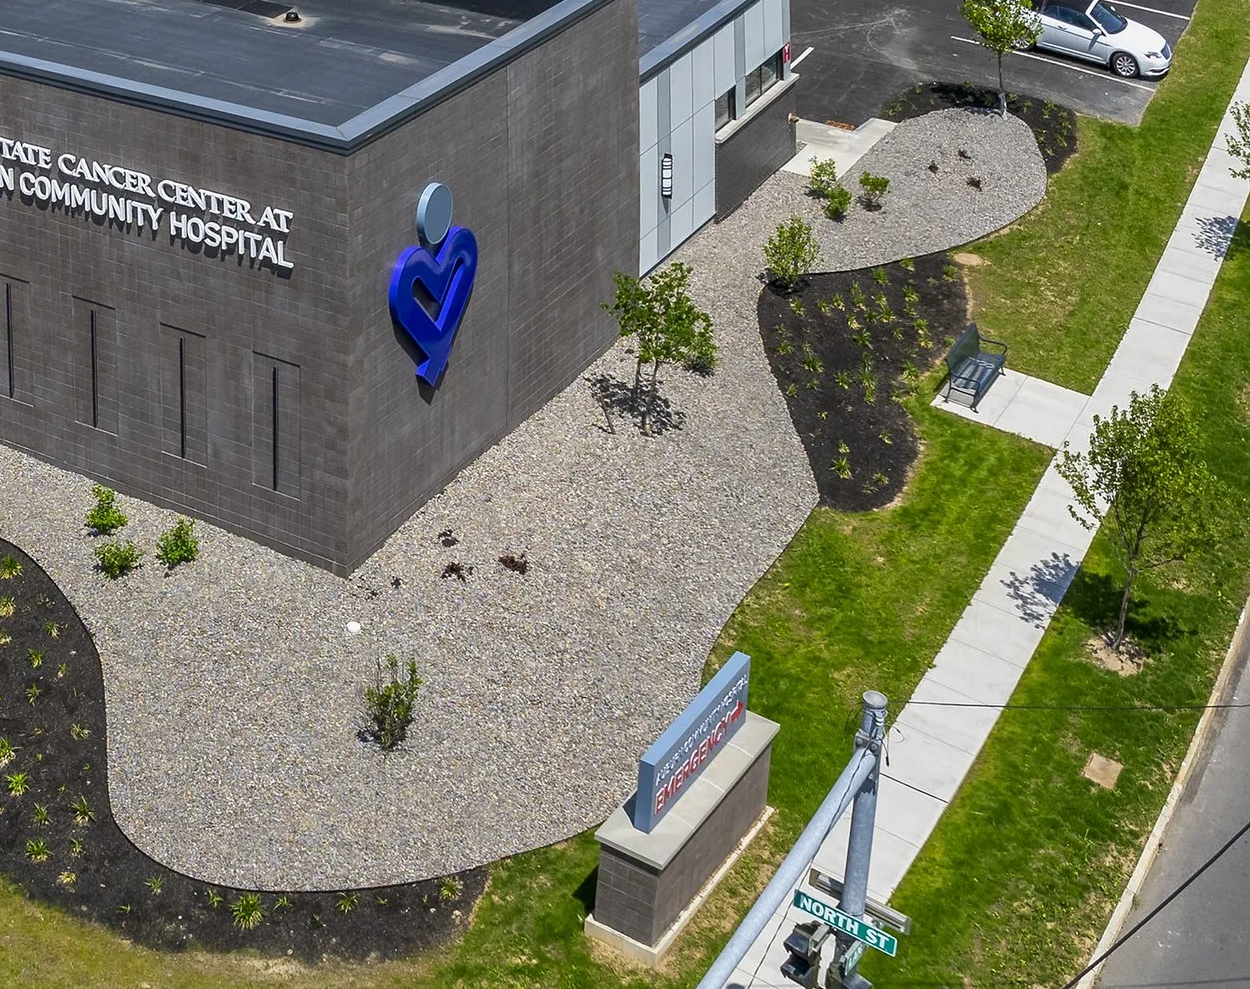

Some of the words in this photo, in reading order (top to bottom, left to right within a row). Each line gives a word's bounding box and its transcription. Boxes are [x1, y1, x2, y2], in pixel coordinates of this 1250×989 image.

[20, 172, 164, 231] COMMUNITY
[169, 211, 294, 269] HOSPITAL
[57, 153, 156, 198] CANCER
[157, 179, 256, 224] CENTER
[256, 205, 293, 233] AT
[655, 713, 731, 815] EMERGENCY
[799, 895, 860, 935] NORTH
[865, 928, 890, 949] ST
